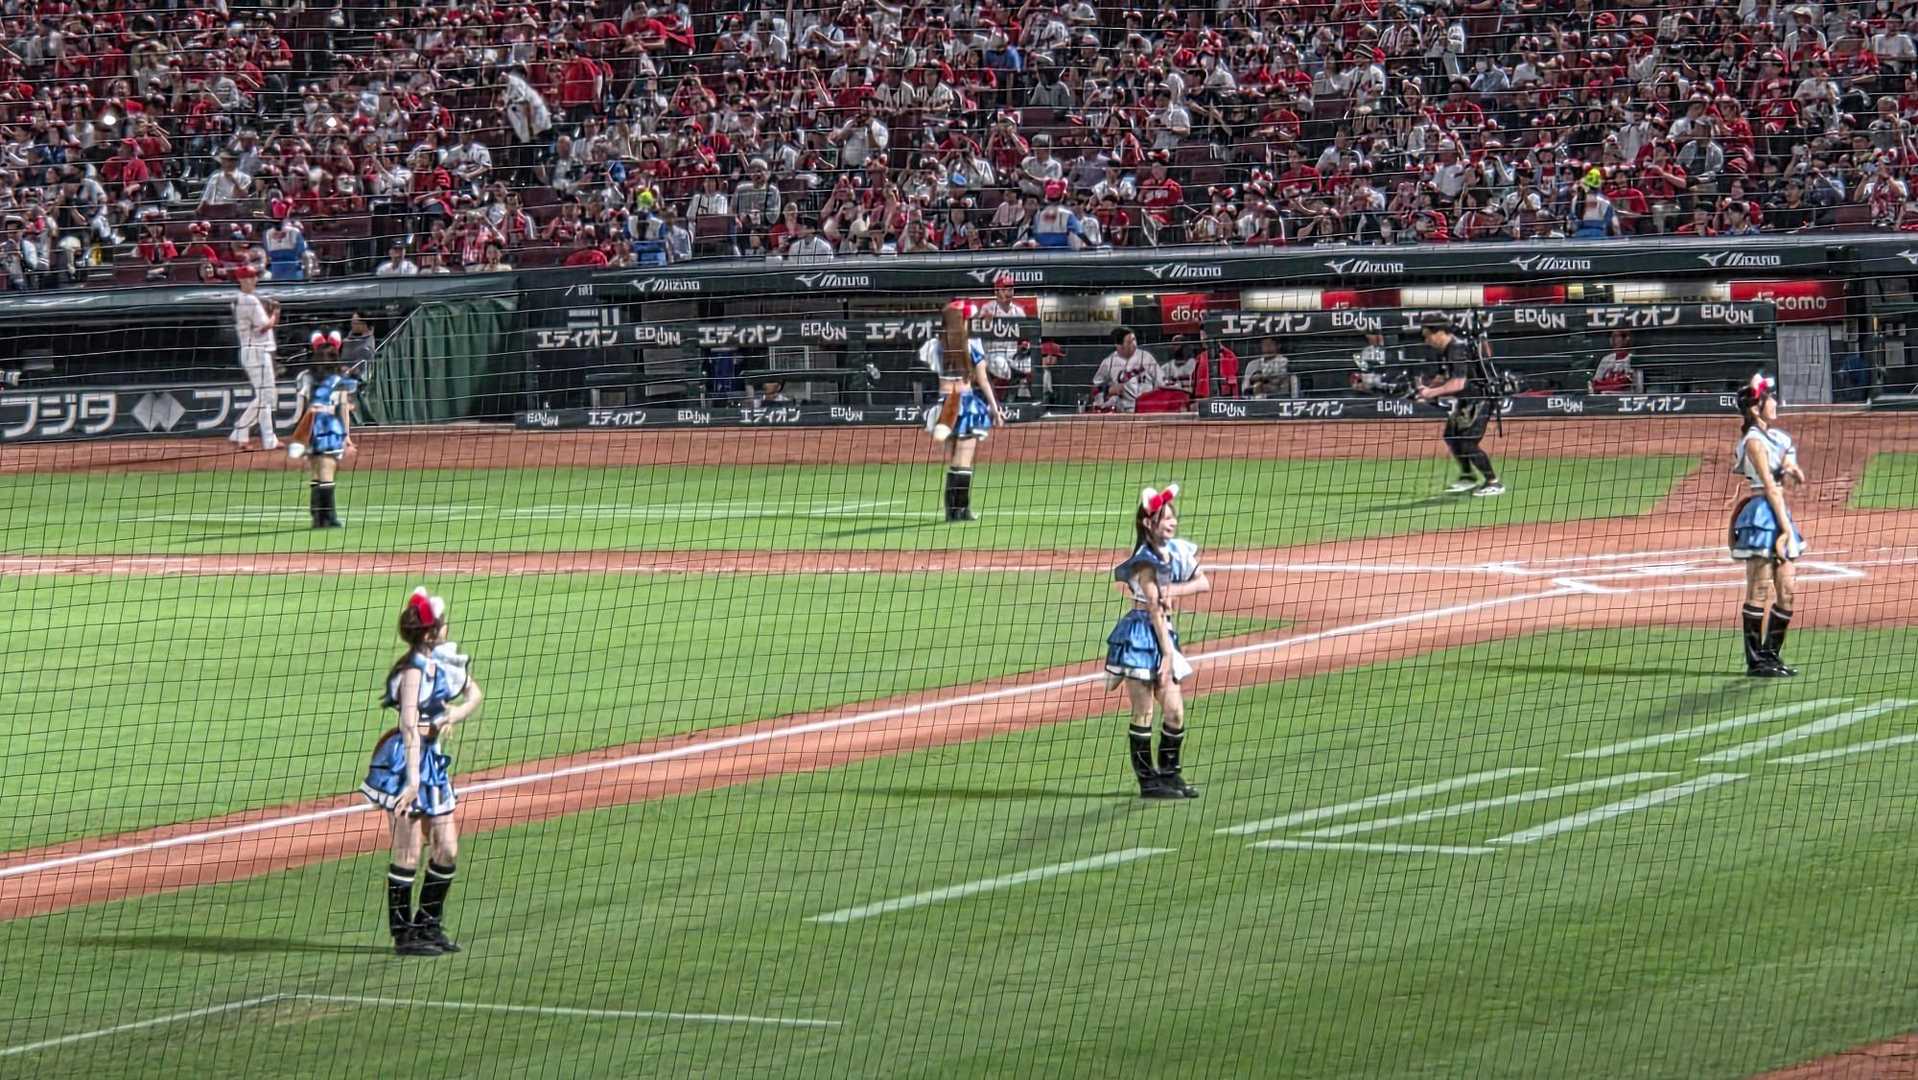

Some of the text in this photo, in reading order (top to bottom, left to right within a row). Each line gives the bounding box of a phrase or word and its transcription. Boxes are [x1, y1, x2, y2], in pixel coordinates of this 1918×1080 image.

[1222, 313, 1311, 333] エディオン
[1586, 305, 1680, 327] エディオン
[537, 330, 618, 348] エディオン
[698, 325, 783, 345] エディオン
[0, 392, 117, 438] フジタ
[588, 411, 646, 426] エディオン
[740, 408, 801, 423] エディオン
[1279, 401, 1344, 417] エディオン
[1618, 397, 1686, 412] エディオン
